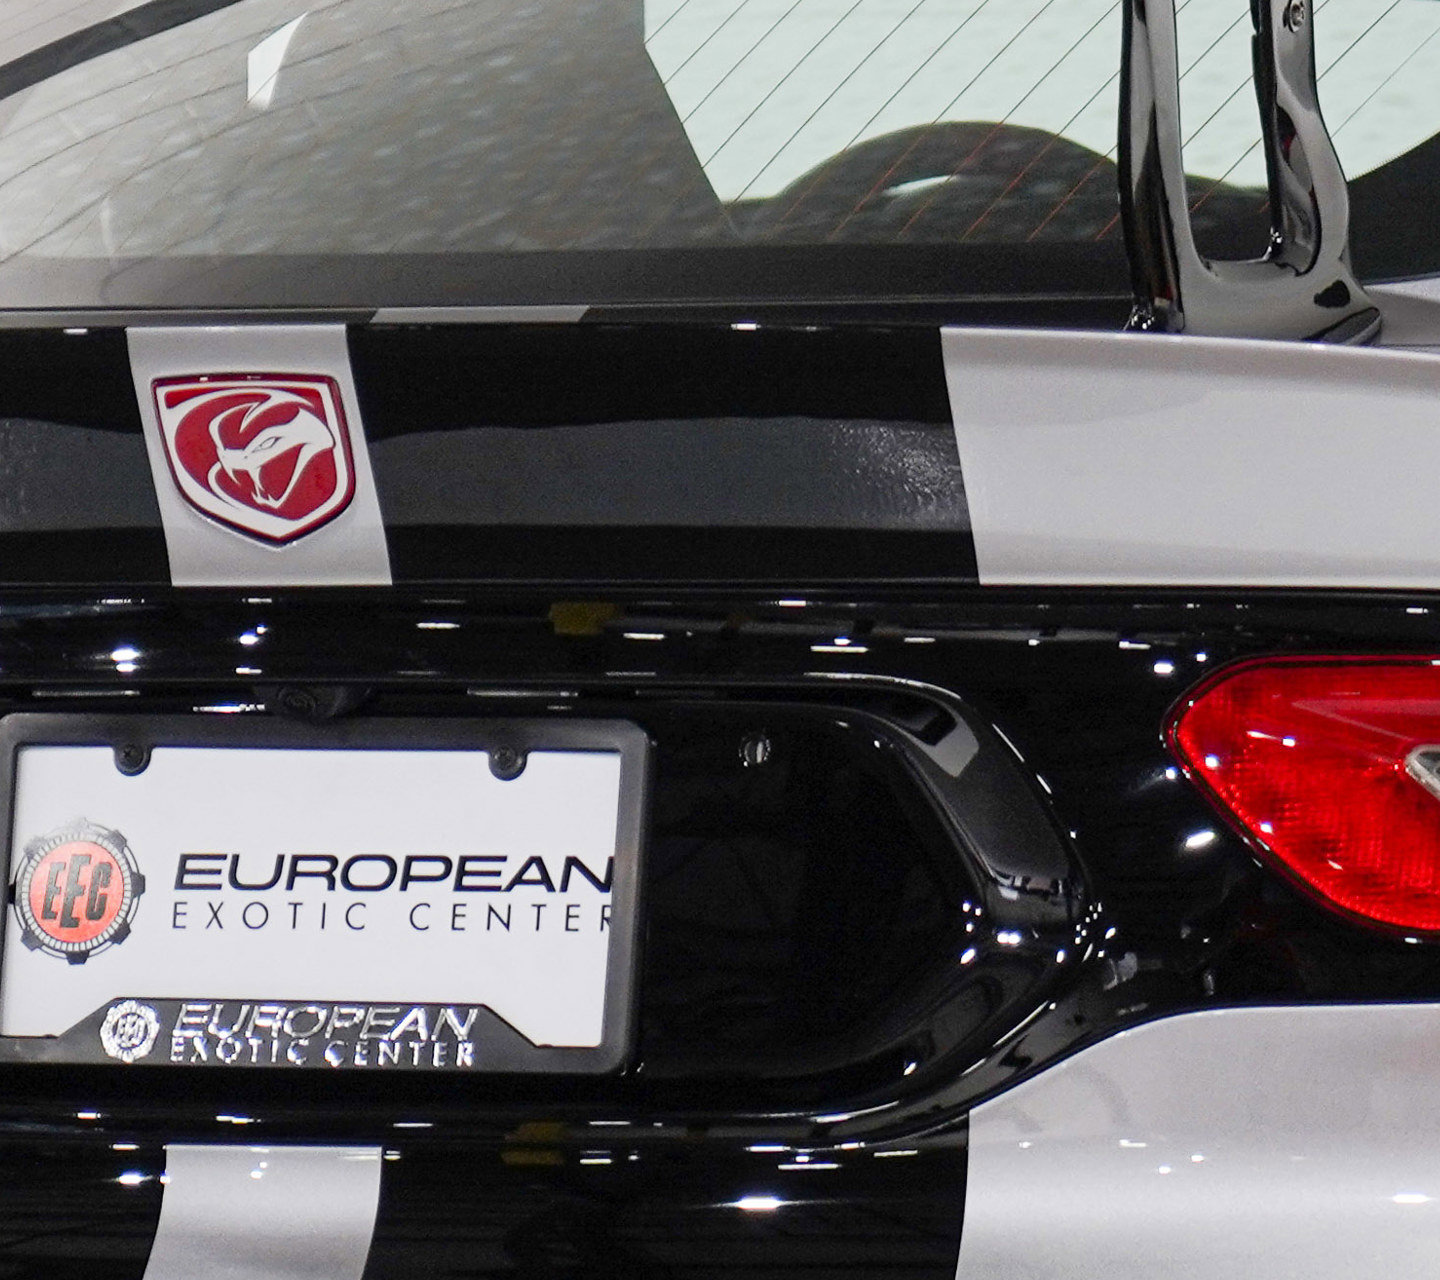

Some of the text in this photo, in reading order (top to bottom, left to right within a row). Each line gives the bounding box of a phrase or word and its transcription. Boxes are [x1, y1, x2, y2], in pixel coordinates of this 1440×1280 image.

[41, 853, 112, 928] EEC
[174, 853, 614, 893] EUROPEAN
[172, 901, 367, 930] EXOTIC
[172, 1004, 478, 1041] EUROPEAN
[170, 1036, 474, 1067] EXOTIC CENTER
